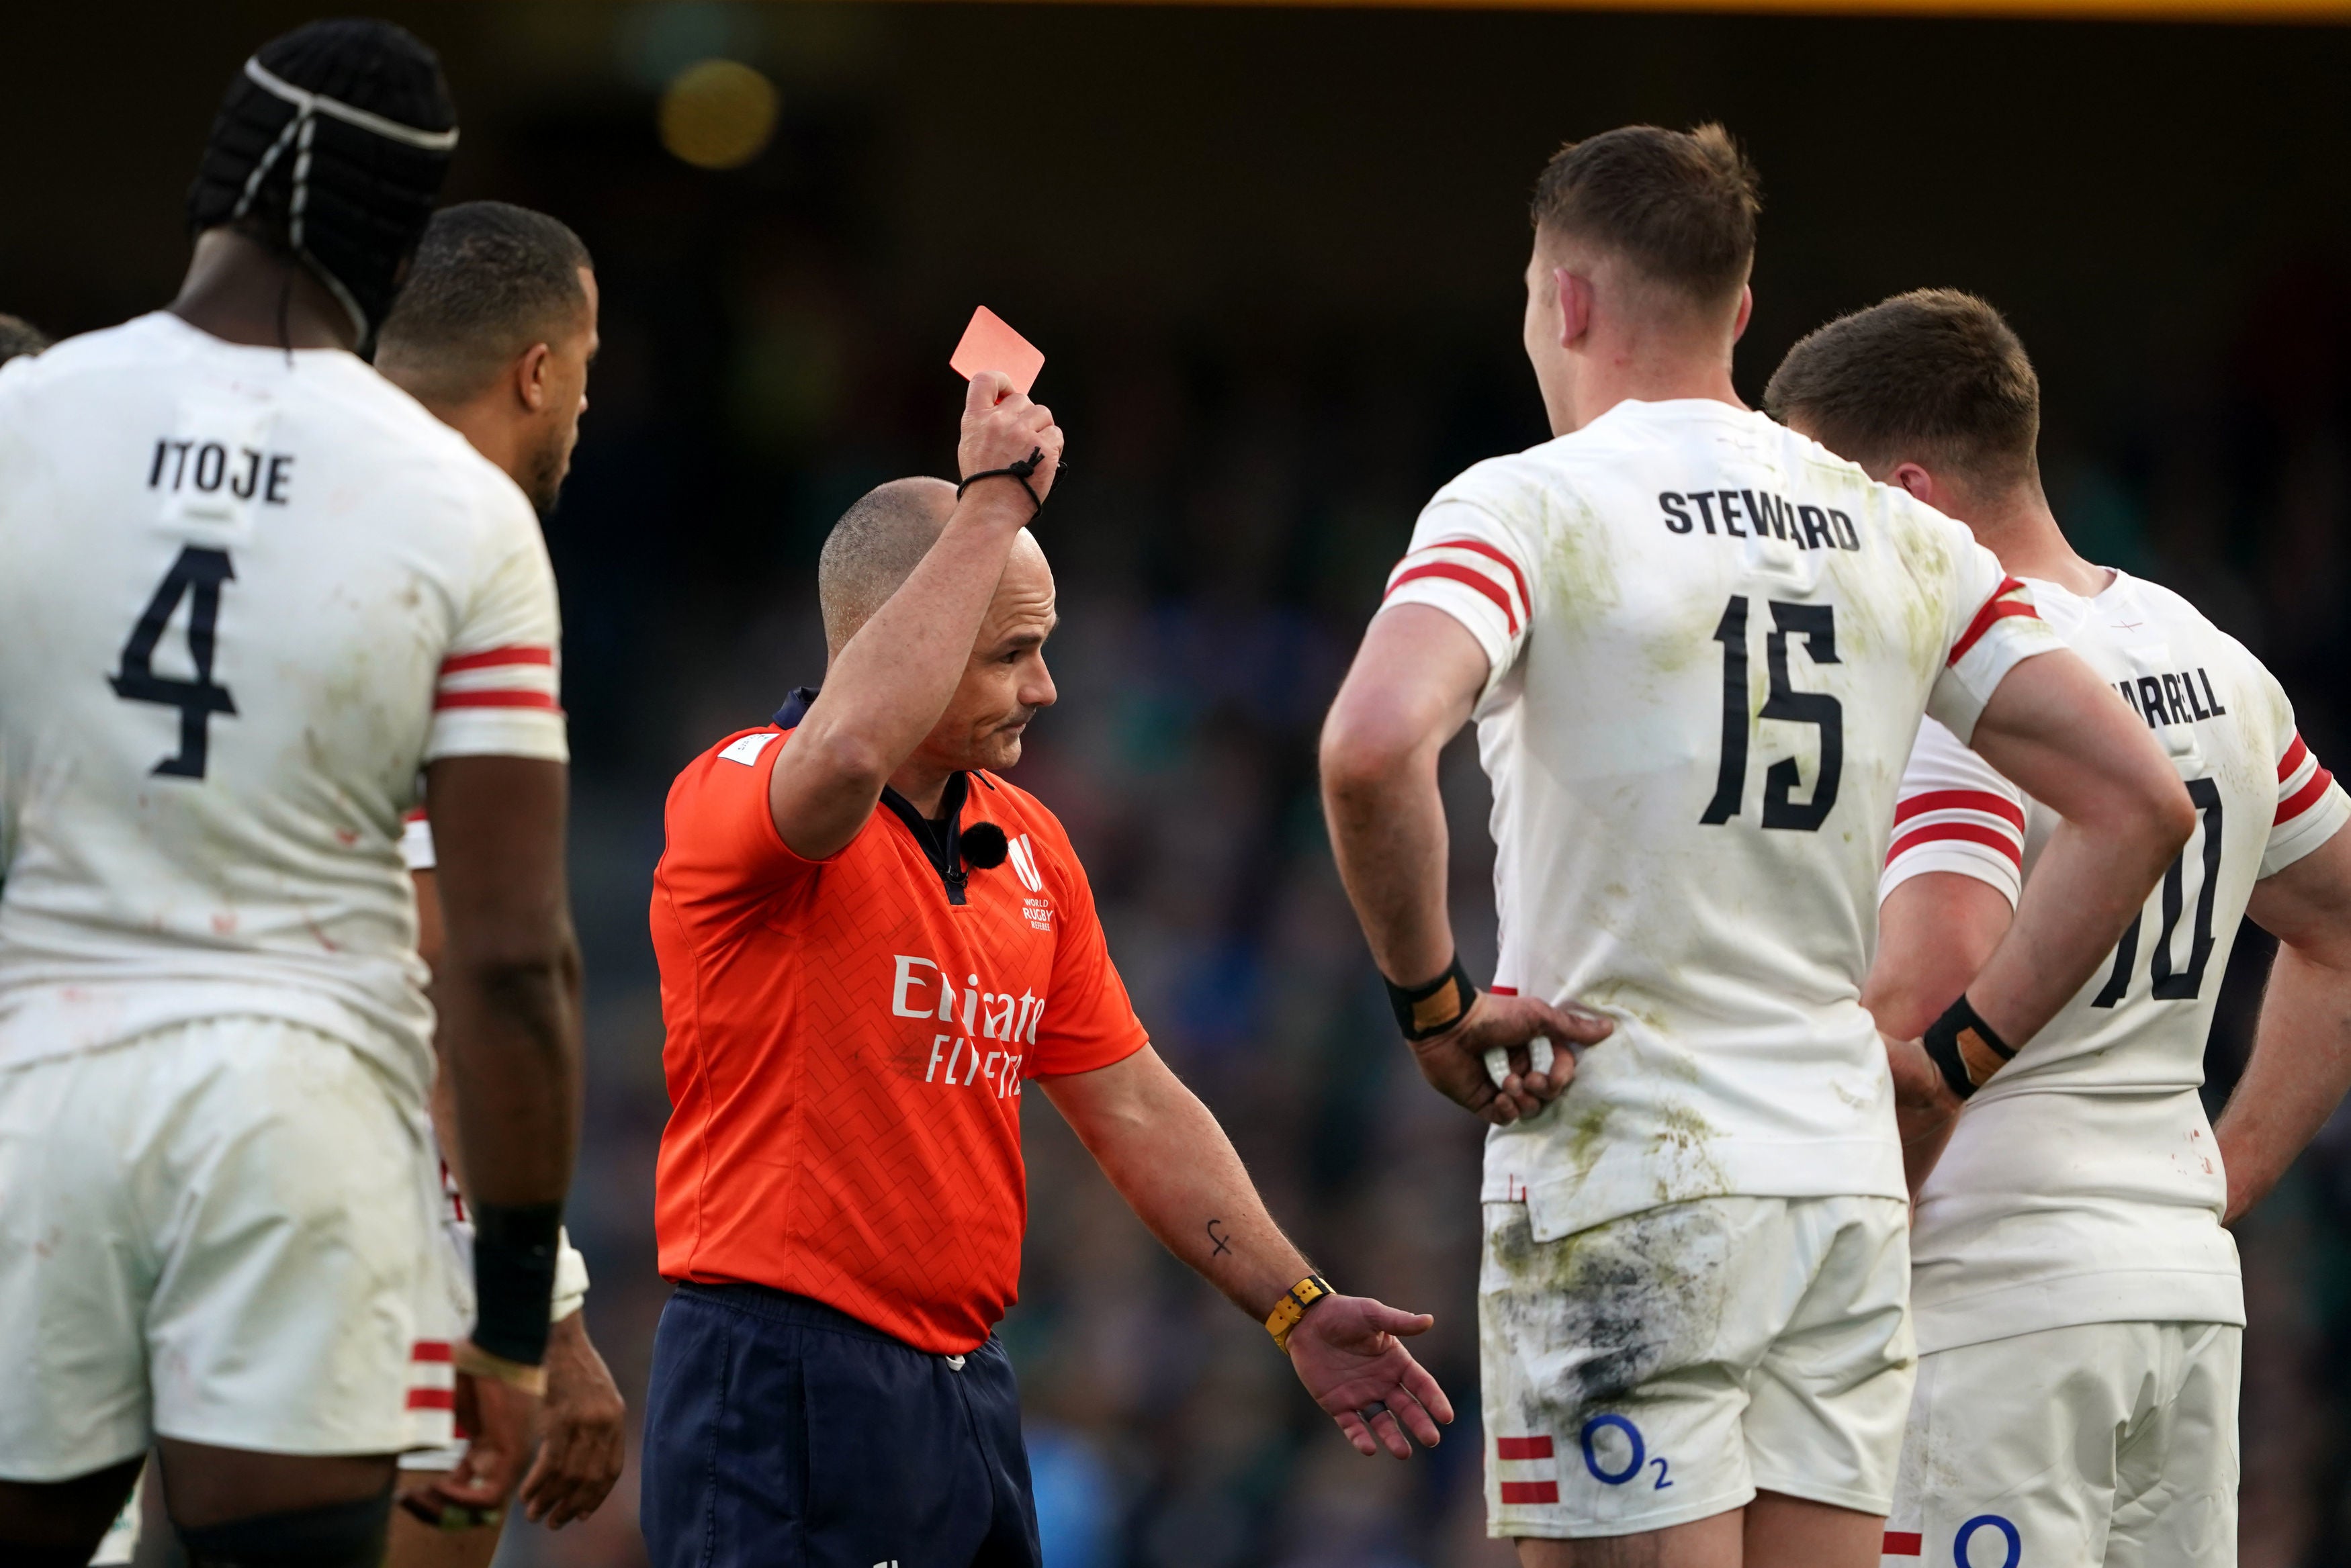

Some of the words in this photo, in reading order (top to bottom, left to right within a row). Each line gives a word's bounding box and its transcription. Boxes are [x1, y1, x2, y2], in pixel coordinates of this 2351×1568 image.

[148, 439, 294, 506] ITOJE
[104, 545, 239, 782] 4
[1698, 594, 1844, 832] 15
[1022, 907, 1053, 922] RUGBY
[1024, 898, 1049, 908] WORLD
[1030, 920, 1051, 932] REFEREE
[1581, 1414, 1674, 1491] O2
